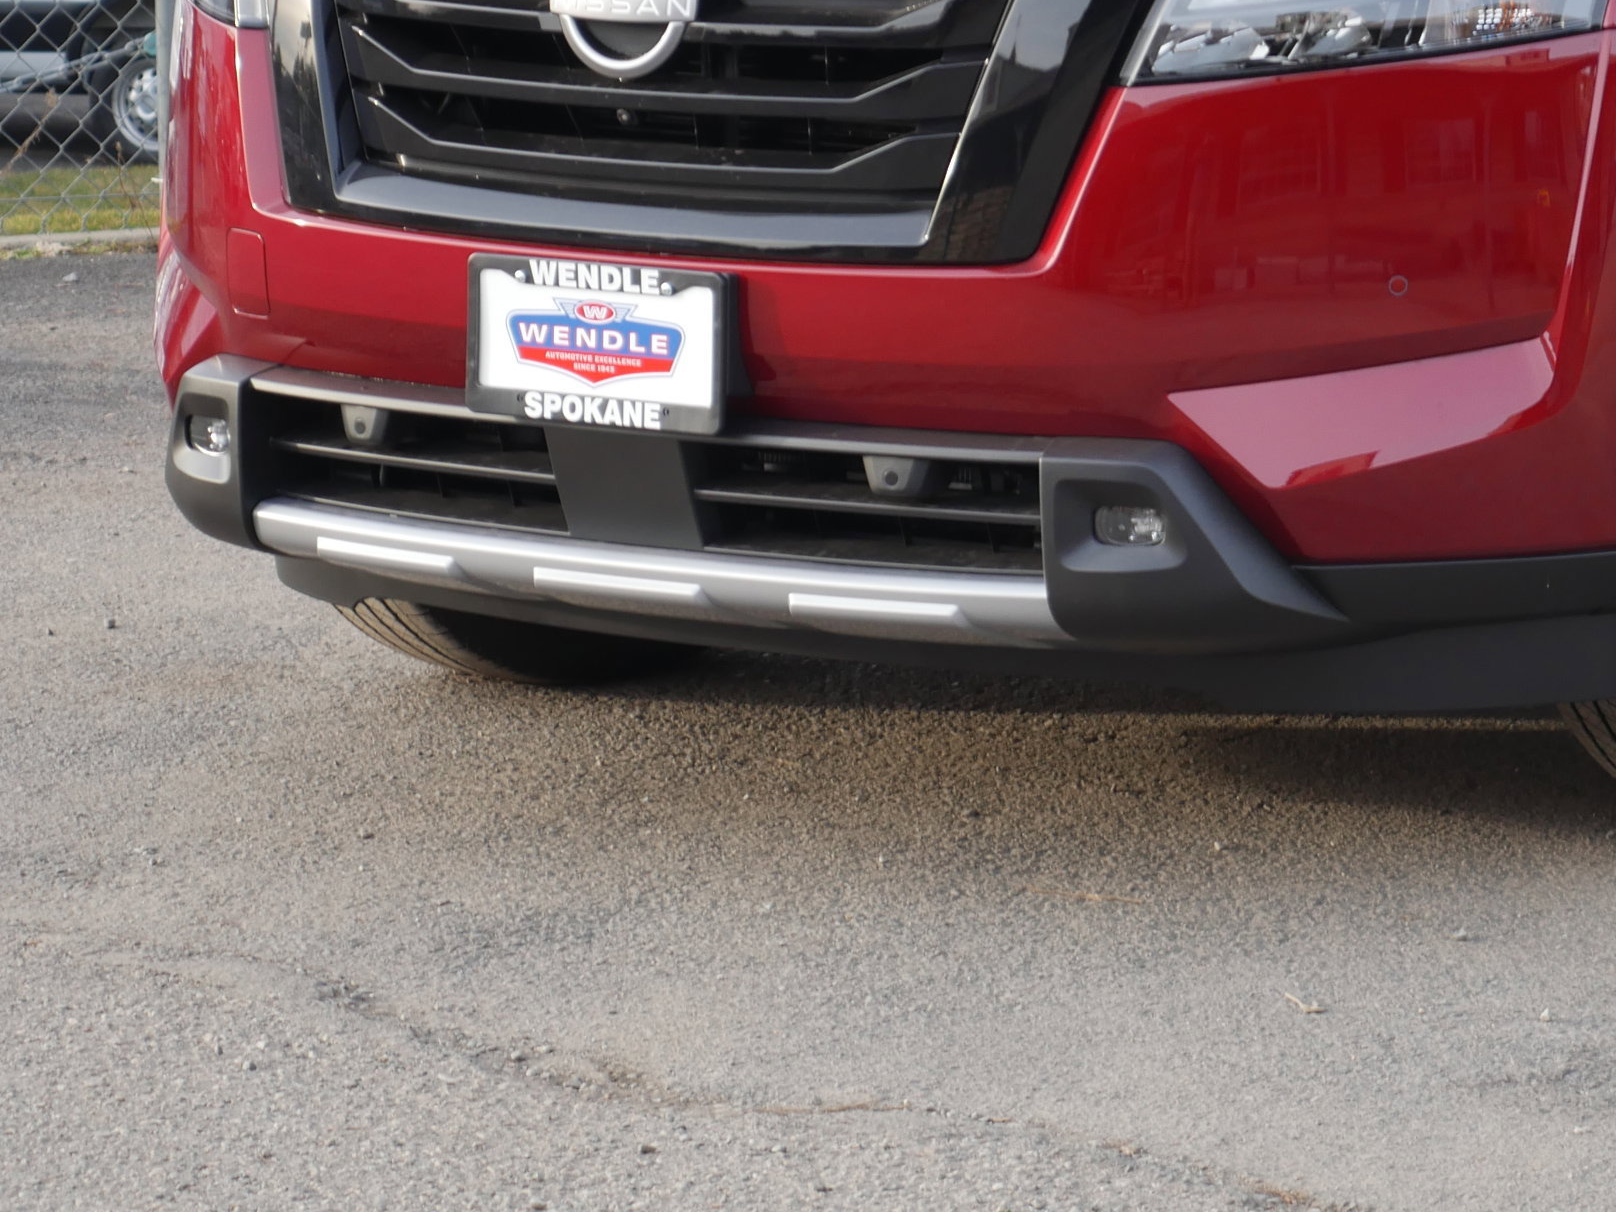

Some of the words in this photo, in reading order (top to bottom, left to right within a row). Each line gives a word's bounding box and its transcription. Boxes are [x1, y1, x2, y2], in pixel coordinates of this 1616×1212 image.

[529, 259, 662, 296] WENDLE
[519, 322, 668, 355] WENDLE
[545, 350, 593, 363] AUTOMOTIVE
[524, 391, 662, 430] SPOKANE
